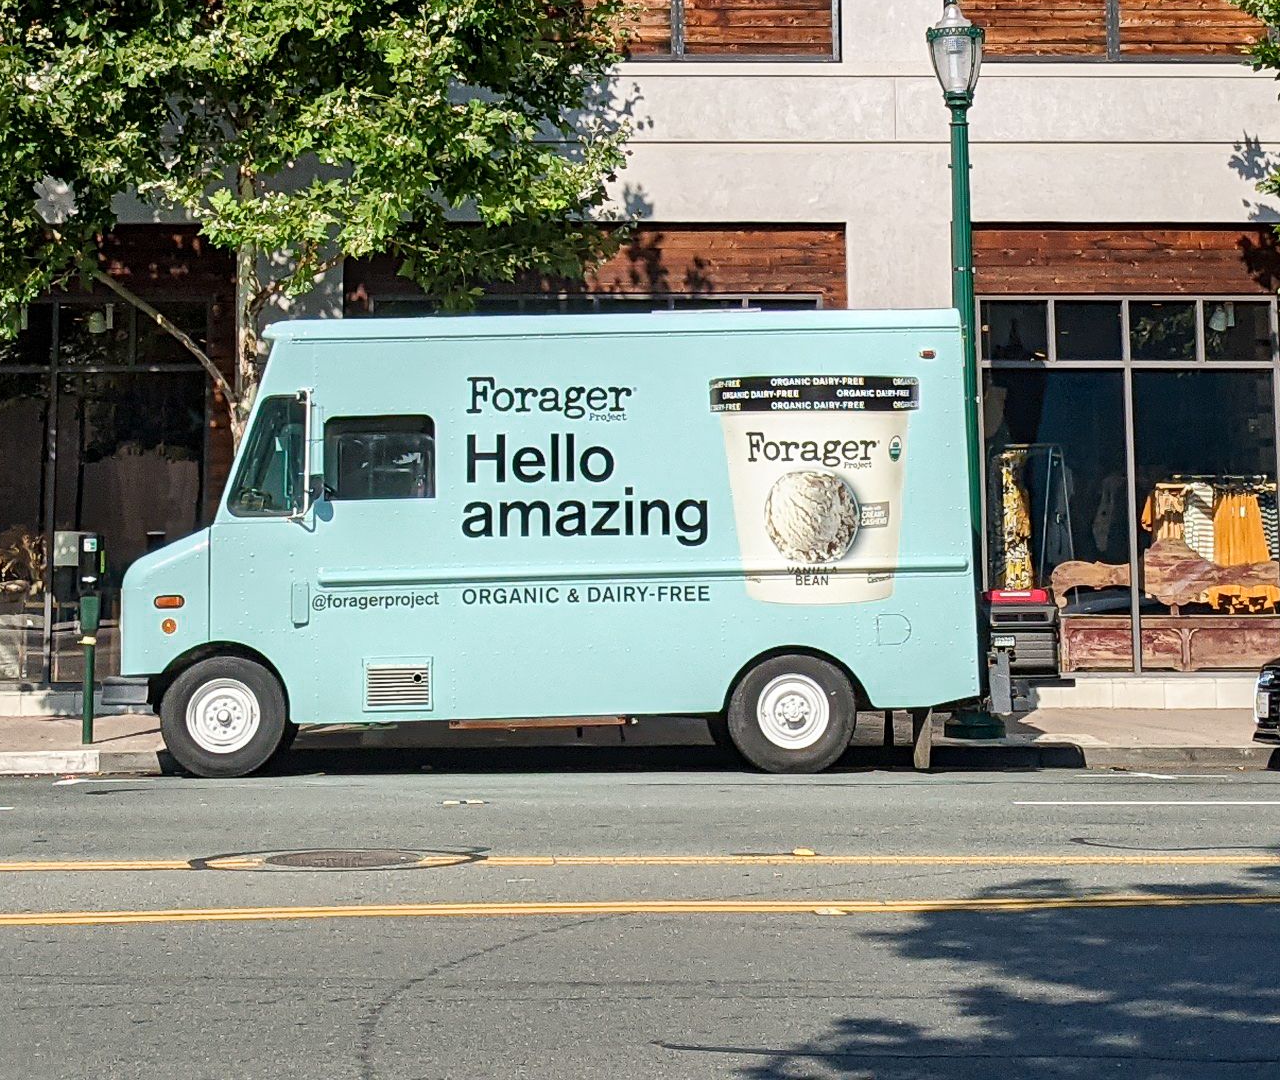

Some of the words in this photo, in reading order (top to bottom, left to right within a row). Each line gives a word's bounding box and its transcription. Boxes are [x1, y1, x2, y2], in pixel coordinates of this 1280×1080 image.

[770, 378, 811, 387] ORGANIC
[812, 377, 864, 386] DAIRY-FREE
[466, 377, 632, 419] Forager
[722, 391, 750, 400] ORGANIC
[751, 390, 800, 399] DAIRY-FREE
[836, 389, 875, 397] ORGANIC
[876, 389, 910, 398] DAIRY-FREE
[771, 401, 812, 410] ORGANIC
[813, 401, 865, 410] DAIRY-FREE
[588, 413, 627, 422] Project
[745, 431, 877, 468] Forager
[466, 433, 615, 483] Hello
[843, 461, 873, 469] Project
[461, 486, 708, 547] amazing
[786, 566, 838, 576] VANILLA
[795, 575, 829, 586] BEAN
[461, 587, 560, 605] ORGANIC
[567, 588, 580, 603] &
[587, 585, 711, 603] DAIRY-FREE
[311, 592, 440, 612] @foragerproject
